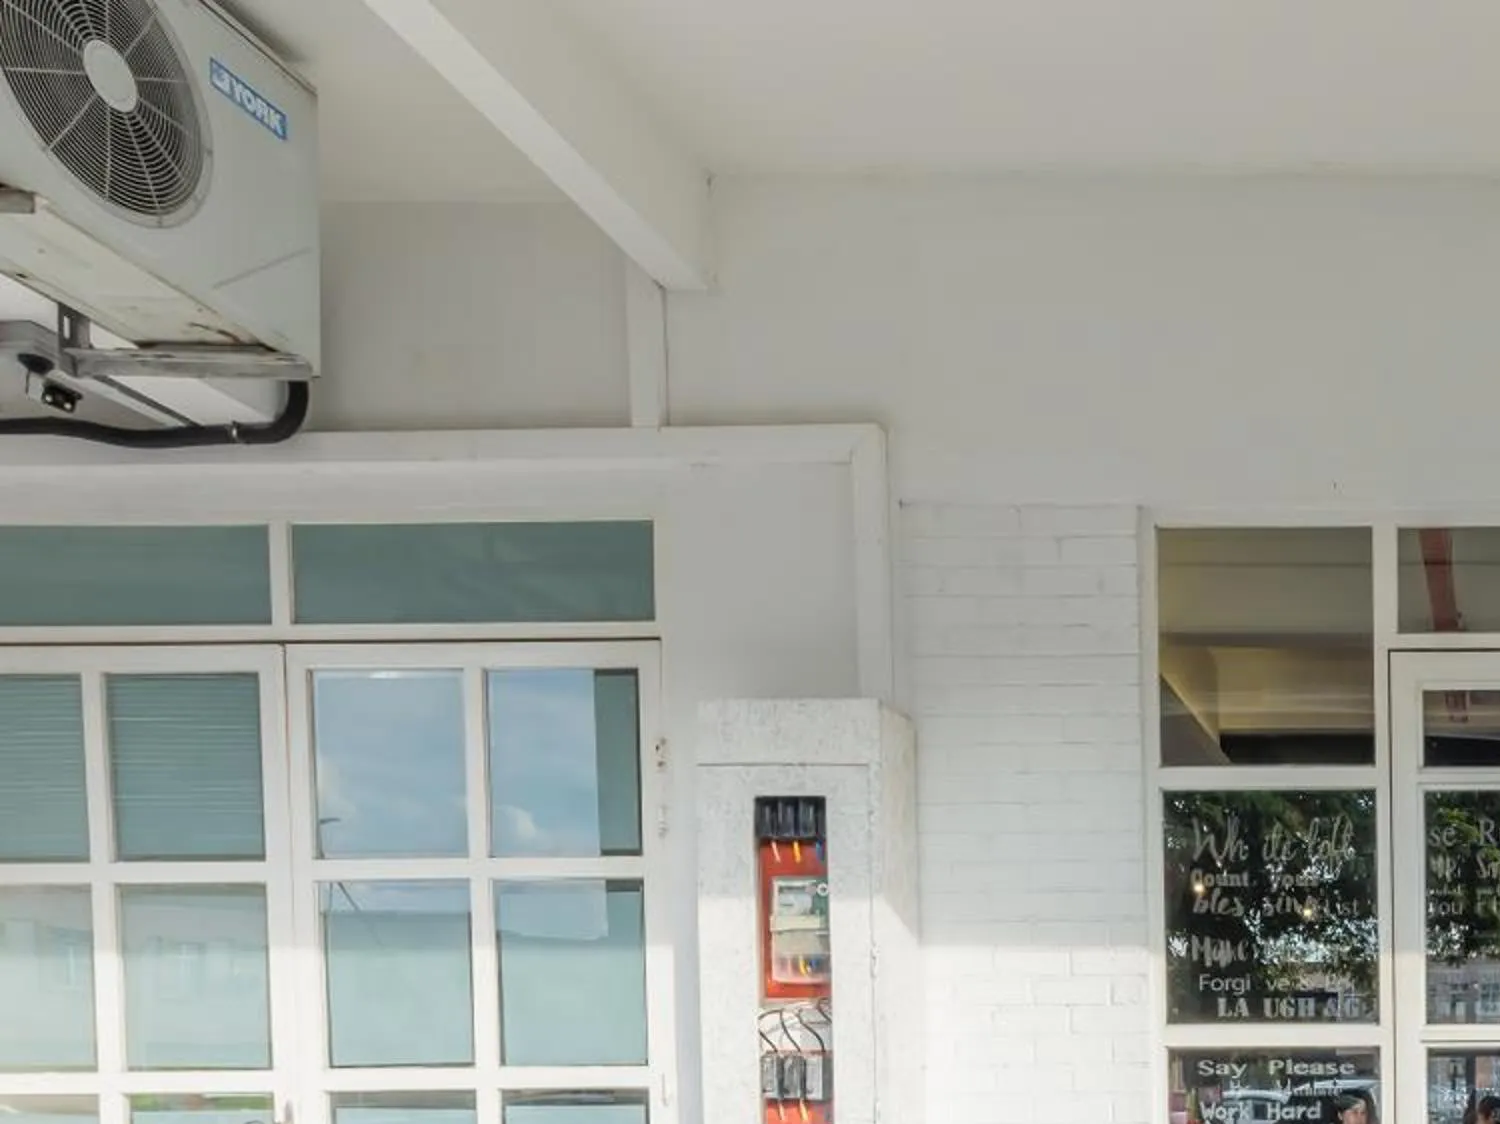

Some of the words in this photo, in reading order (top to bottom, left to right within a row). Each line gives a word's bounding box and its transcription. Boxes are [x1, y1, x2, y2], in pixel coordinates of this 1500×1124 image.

[231, 78, 284, 136] YORK
[1198, 1059, 1248, 1079] Say
[1268, 1059, 1356, 1076] Please
[1199, 1103, 1250, 1121] Work
[1267, 1101, 1322, 1120] Hard
